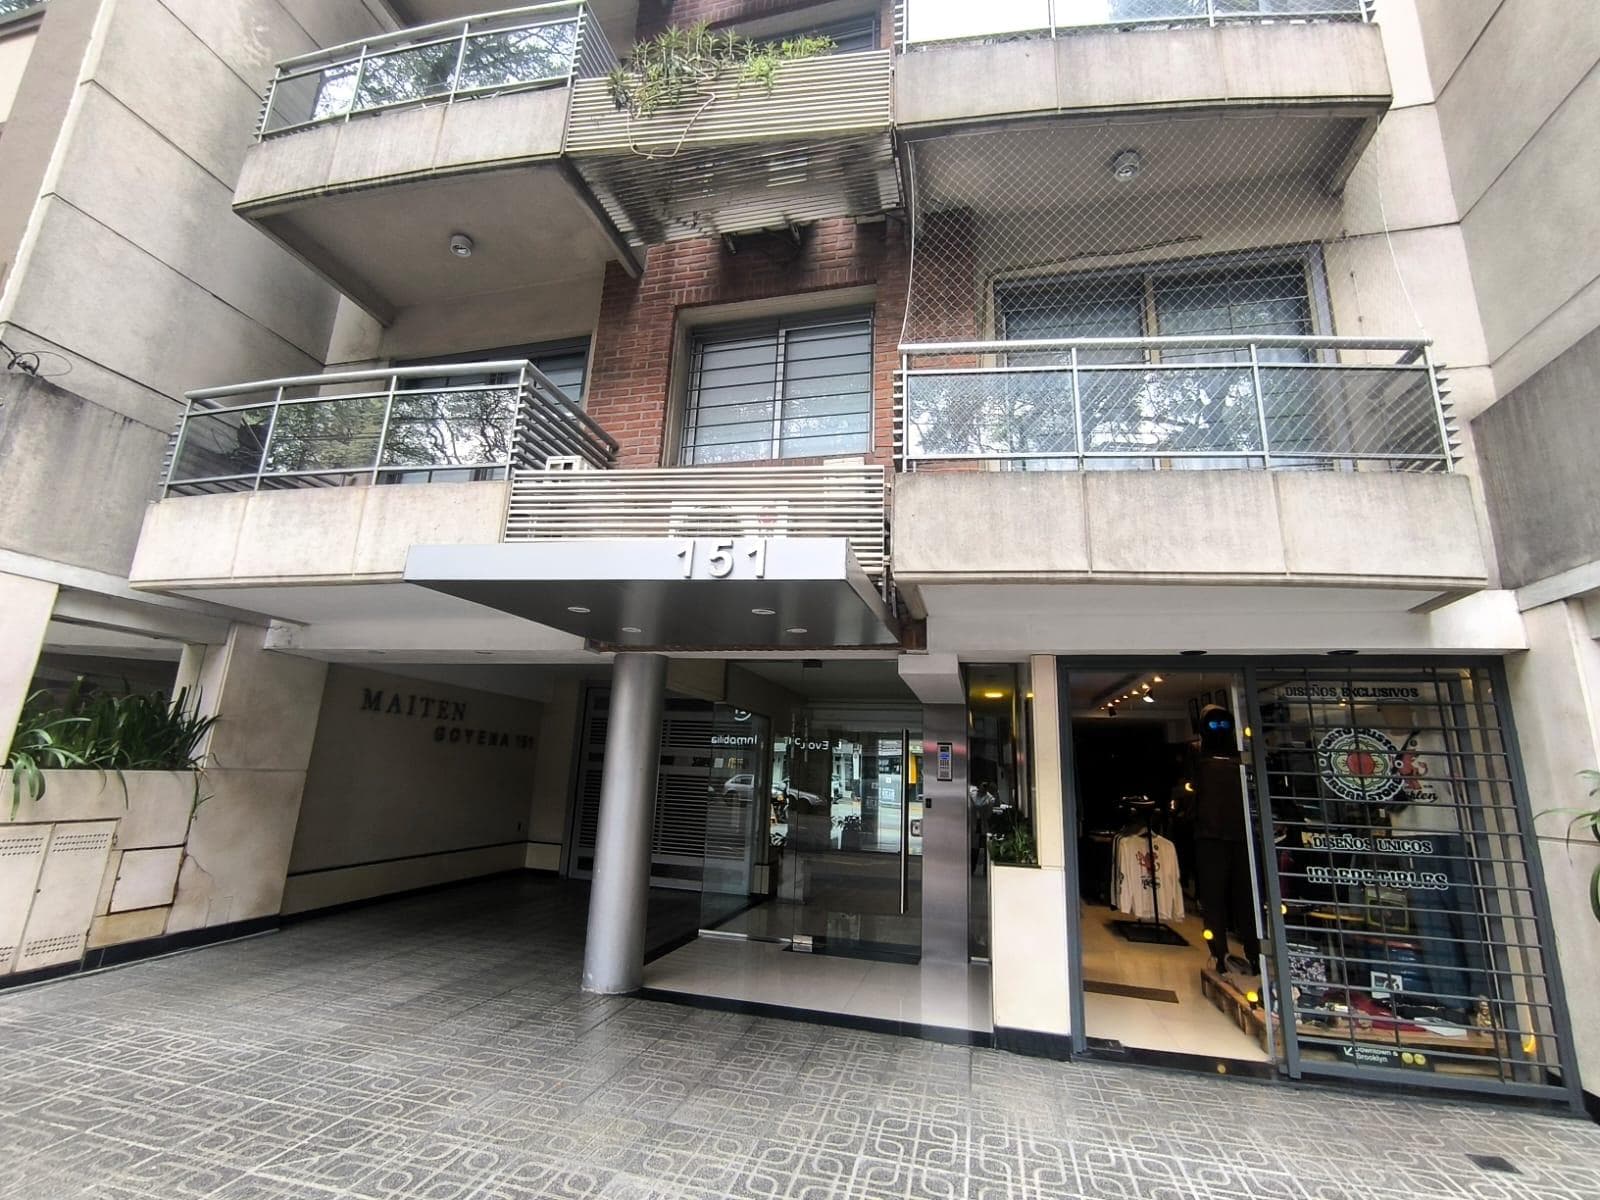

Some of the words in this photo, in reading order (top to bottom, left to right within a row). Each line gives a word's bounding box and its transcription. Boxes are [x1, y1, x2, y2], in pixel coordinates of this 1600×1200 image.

[677, 539, 767, 579] 151
[360, 687, 467, 721] MAITEN
[1285, 683, 1338, 697] DISEÑOS
[1341, 685, 1419, 698] EXCLUSIVOS
[1312, 833, 1372, 851] DISEÑOS
[1376, 838, 1433, 854] UNICOS
